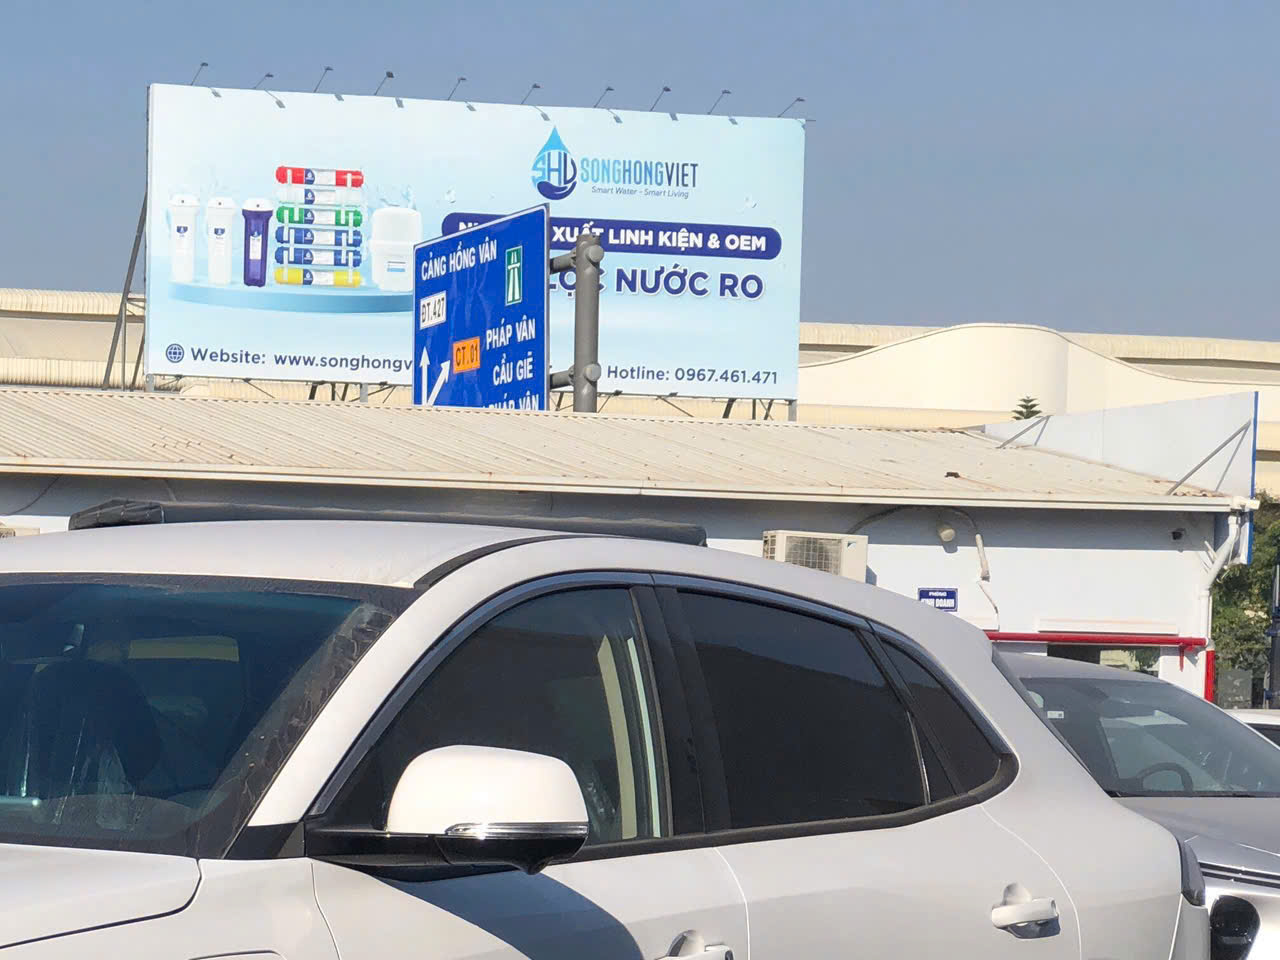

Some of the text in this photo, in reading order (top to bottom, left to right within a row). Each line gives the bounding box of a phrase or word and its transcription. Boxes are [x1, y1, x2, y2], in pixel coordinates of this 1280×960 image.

[580, 157, 699, 188] SONGHONGVIET
[591, 185, 614, 195] Smart
[615, 186, 638, 196] Water
[644, 188, 667, 198] Smart
[667, 189, 689, 200] Living
[608, 228, 654, 247] LINH
[658, 228, 704, 251] KIỆN
[707, 231, 721, 249] &
[725, 234, 767, 252] OEM
[421, 251, 447, 281] CẢNG
[478, 236, 498, 264] VÂN
[615, 262, 709, 297] NƯỚC
[719, 272, 764, 299] RO
[421, 297, 445, 323] ĐT.427
[486, 314, 536, 351] PHÁP VÂN
[191, 347, 413, 372] Website: www.songhongv
[455, 343, 479, 367] CT.01
[607, 365, 778, 385] Hotline: 0967.461.471
